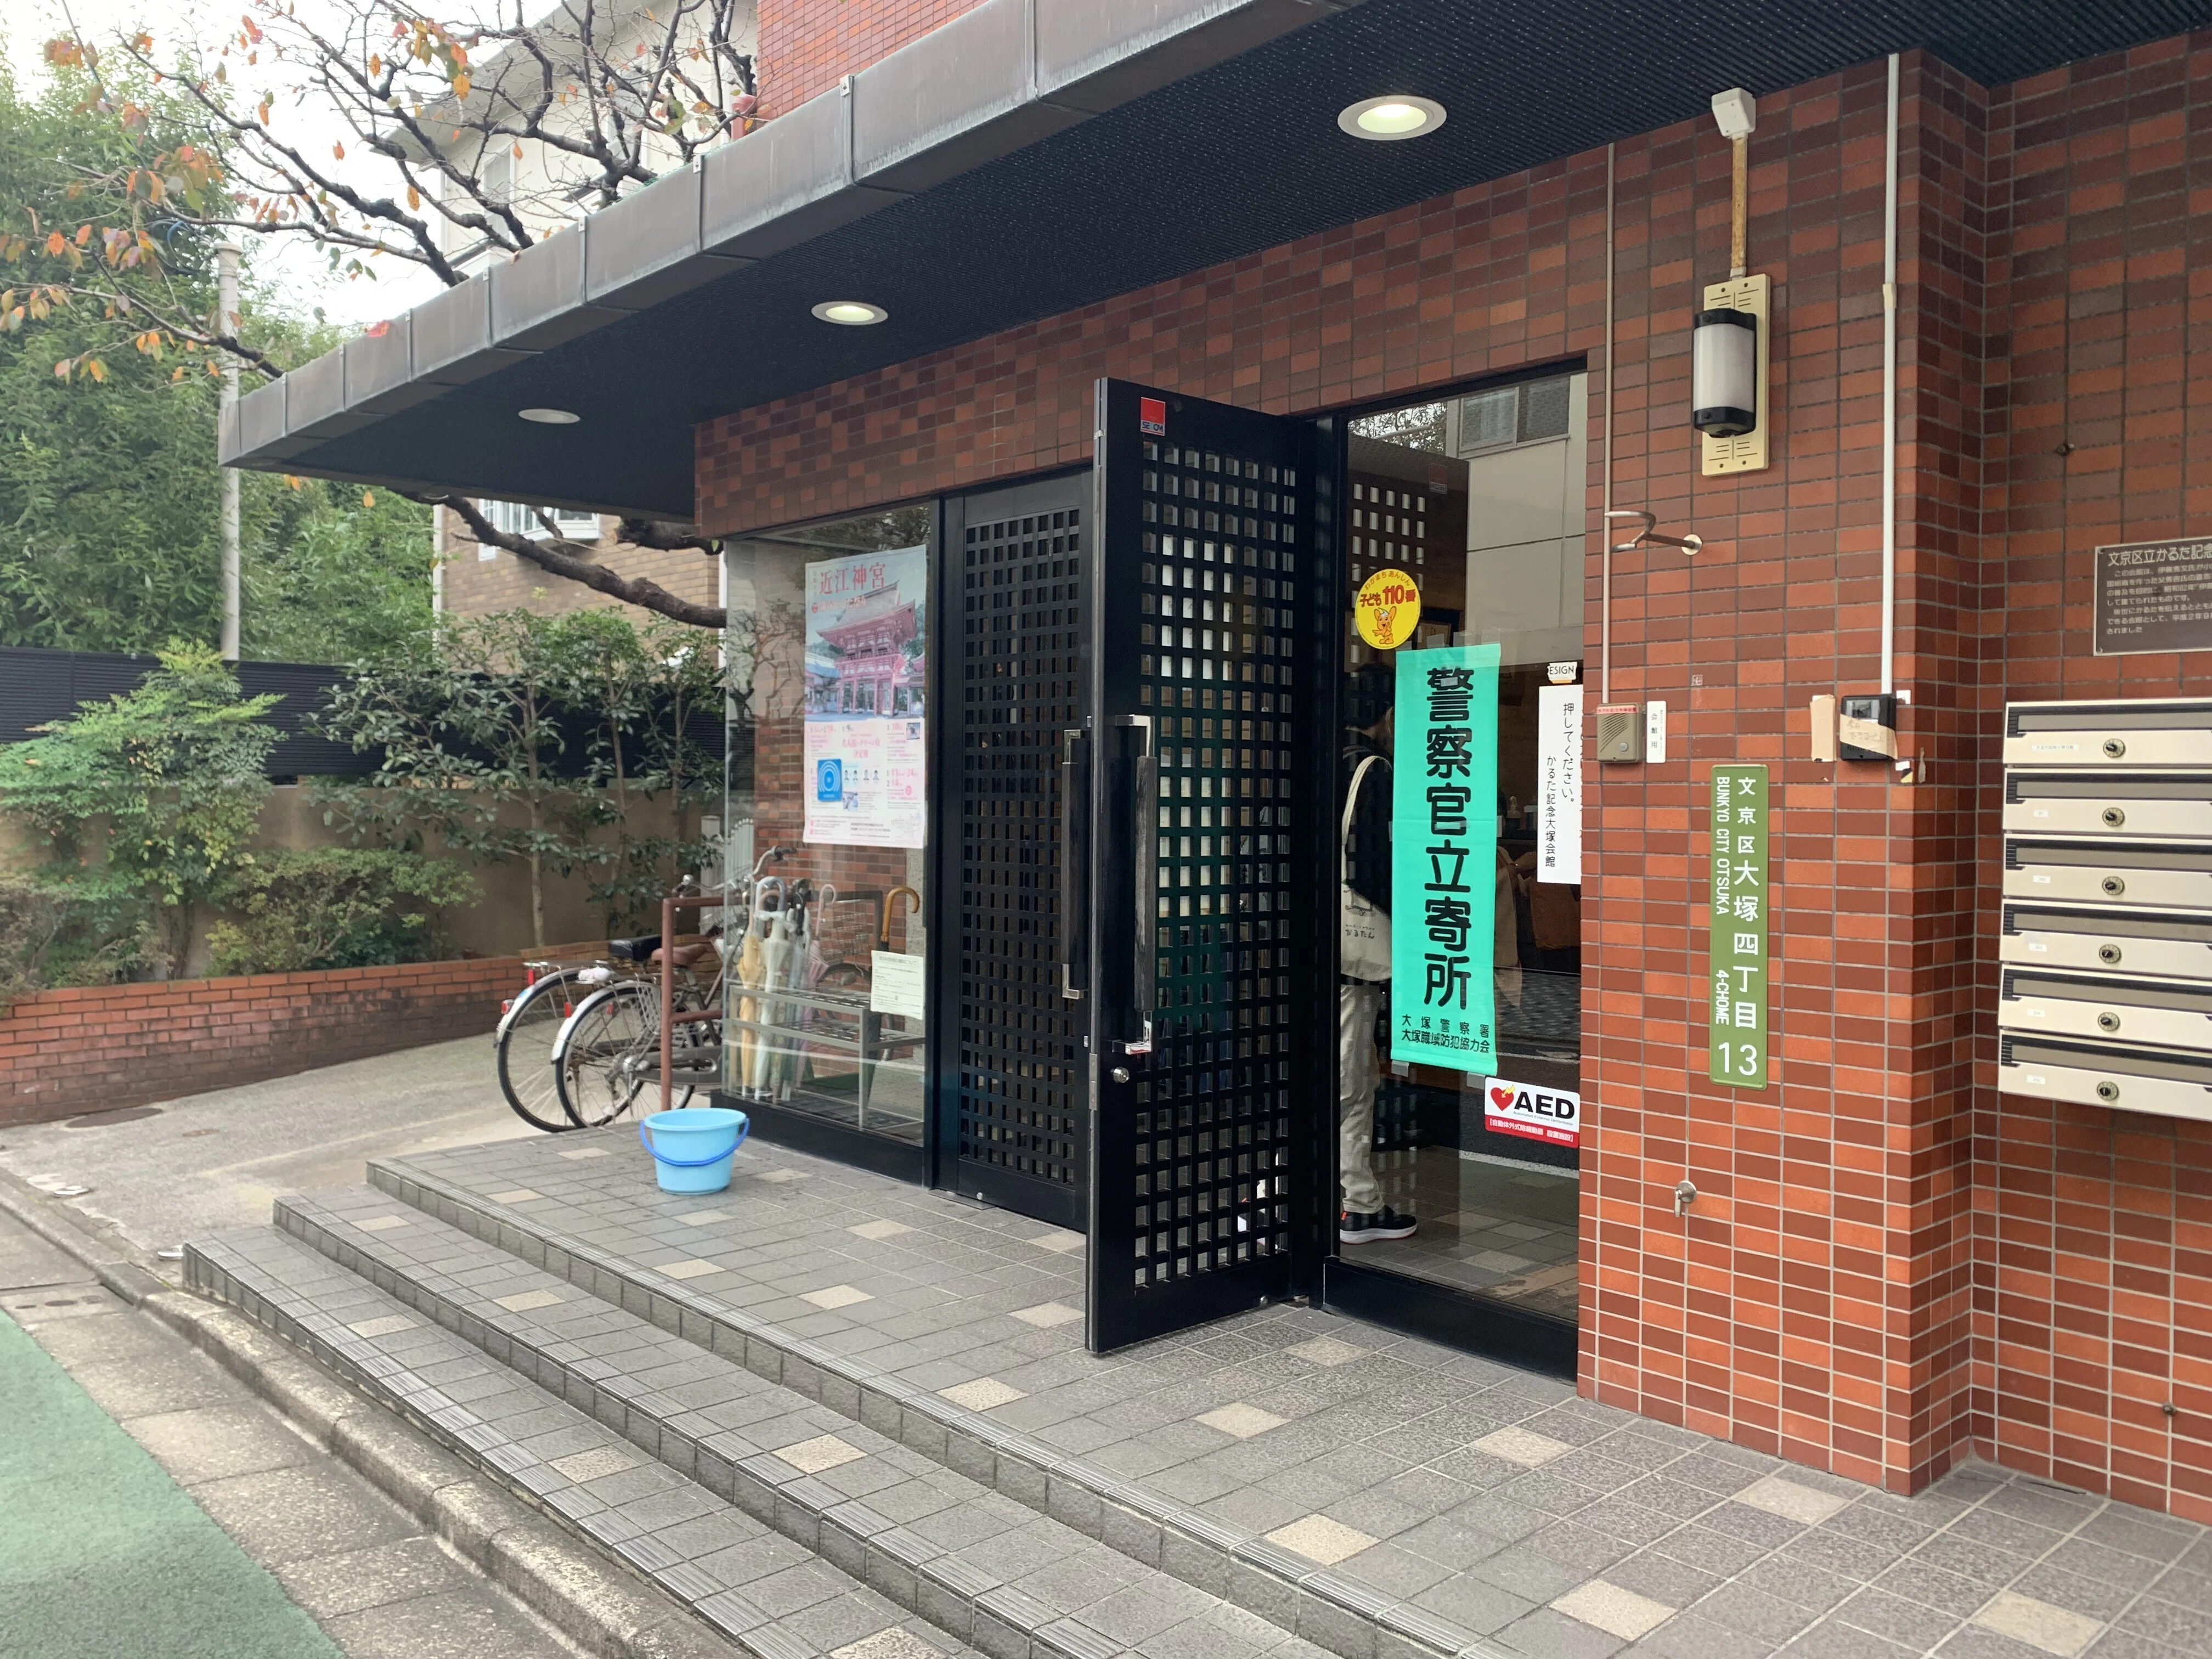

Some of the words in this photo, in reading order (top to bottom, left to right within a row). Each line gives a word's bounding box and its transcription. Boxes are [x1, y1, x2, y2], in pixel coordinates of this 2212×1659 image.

[1142, 421, 1164, 432] SEOM
[2108, 543, 2212, 567] 文京区立かるた記念
[820, 562, 886, 595] 近江神宮
[1364, 572, 1387, 590] わがまち
[1389, 571, 1411, 586] あんしん
[1549, 665, 1574, 674] ESIGN
[1562, 703, 1575, 802] 押してください。
[1545, 755, 1557, 867] かるた記念大塚会館
[1716, 777, 1730, 822] BUNKYO
[1424, 668, 1475, 1011] 警察官立寄所
[1716, 828, 1730, 853] CITY
[1716, 858, 1730, 915] OTSUKA
[1716, 969, 1730, 1025] 4-CHOME
[1401, 1029, 1491, 1054] 大塚職域防犯協力会
[1402, 1014, 1489, 1039] 大塚警察署
[1718, 1042, 1758, 1076] 13
[1514, 1091, 1575, 1119] AED
